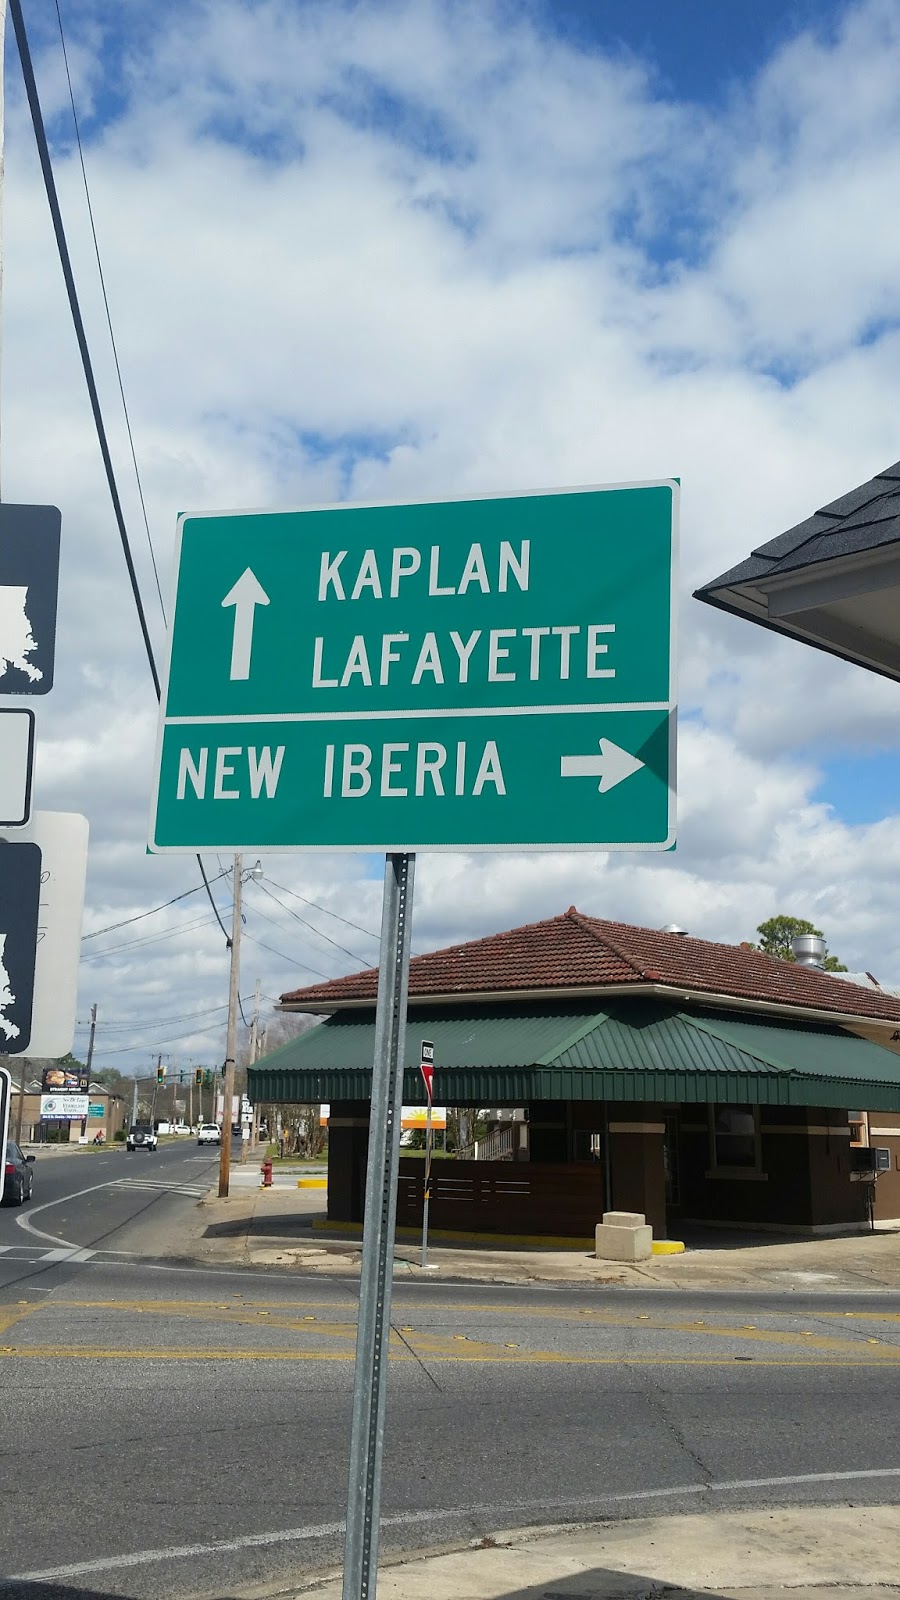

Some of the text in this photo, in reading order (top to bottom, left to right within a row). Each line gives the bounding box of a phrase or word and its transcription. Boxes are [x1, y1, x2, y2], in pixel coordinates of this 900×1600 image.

[319, 540, 530, 601] KAPLAN
[313, 624, 616, 688] LAFAYETTE
[177, 741, 506, 800] NEW IBERIA
[424, 1047, 432, 1058] ONE
